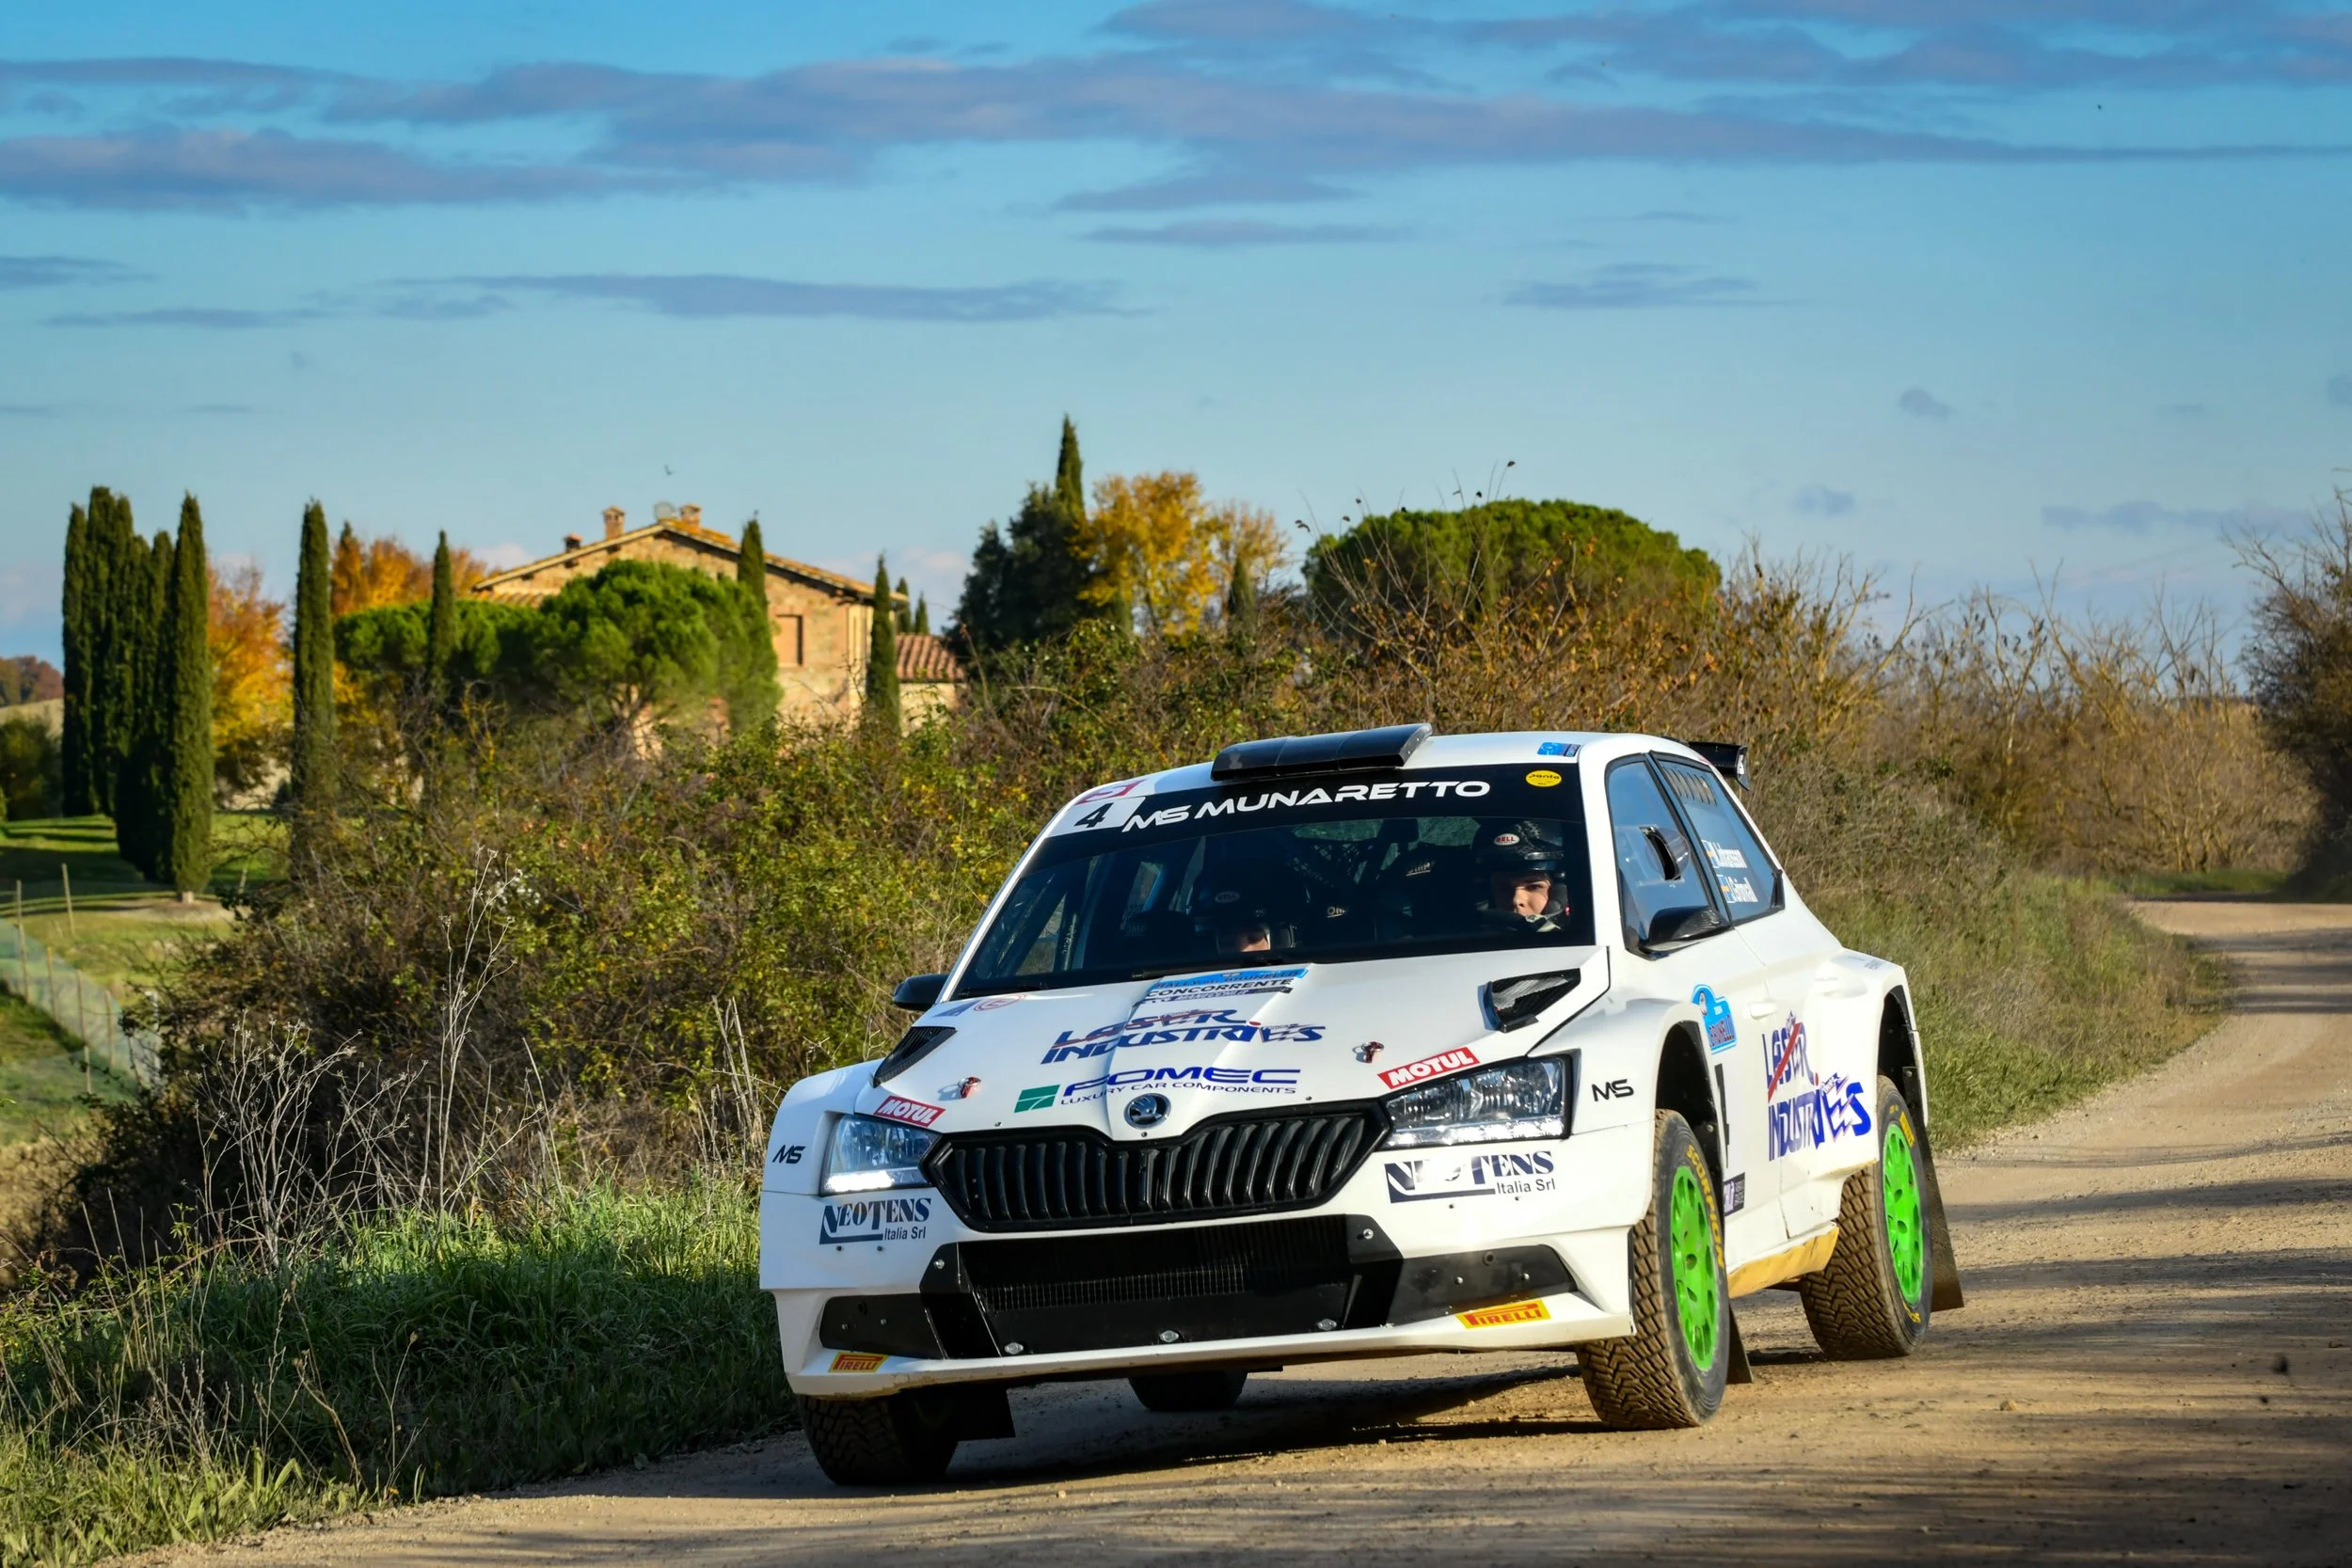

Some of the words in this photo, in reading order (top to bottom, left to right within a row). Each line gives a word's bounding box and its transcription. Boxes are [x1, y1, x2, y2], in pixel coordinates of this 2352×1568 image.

[1073, 802, 1114, 828] 4
[1121, 805, 1191, 832] MS
[1194, 780, 1491, 819] MUNARETTO
[1148, 978, 1294, 998] CONCORRENTE
[1385, 1053, 1474, 1086] MOTUL
[1060, 1085, 1126, 1105] LUXURY
[1131, 1082, 1168, 1091] CAR
[1172, 1082, 1296, 1094] COMPONENTS
[1590, 1078, 1635, 1101] MS
[878, 1100, 935, 1124] MOTUL
[771, 1144, 806, 1164] MS
[1497, 1181, 1532, 1195] Italia
[1536, 1178, 1556, 1192] Srl
[819, 1197, 931, 1244] NEOTENS
[883, 1228, 908, 1241] Italia
[911, 1226, 927, 1240] Srl
[1463, 1303, 1543, 1326] PIRELLI
[833, 1354, 884, 1370] PIRELLI
